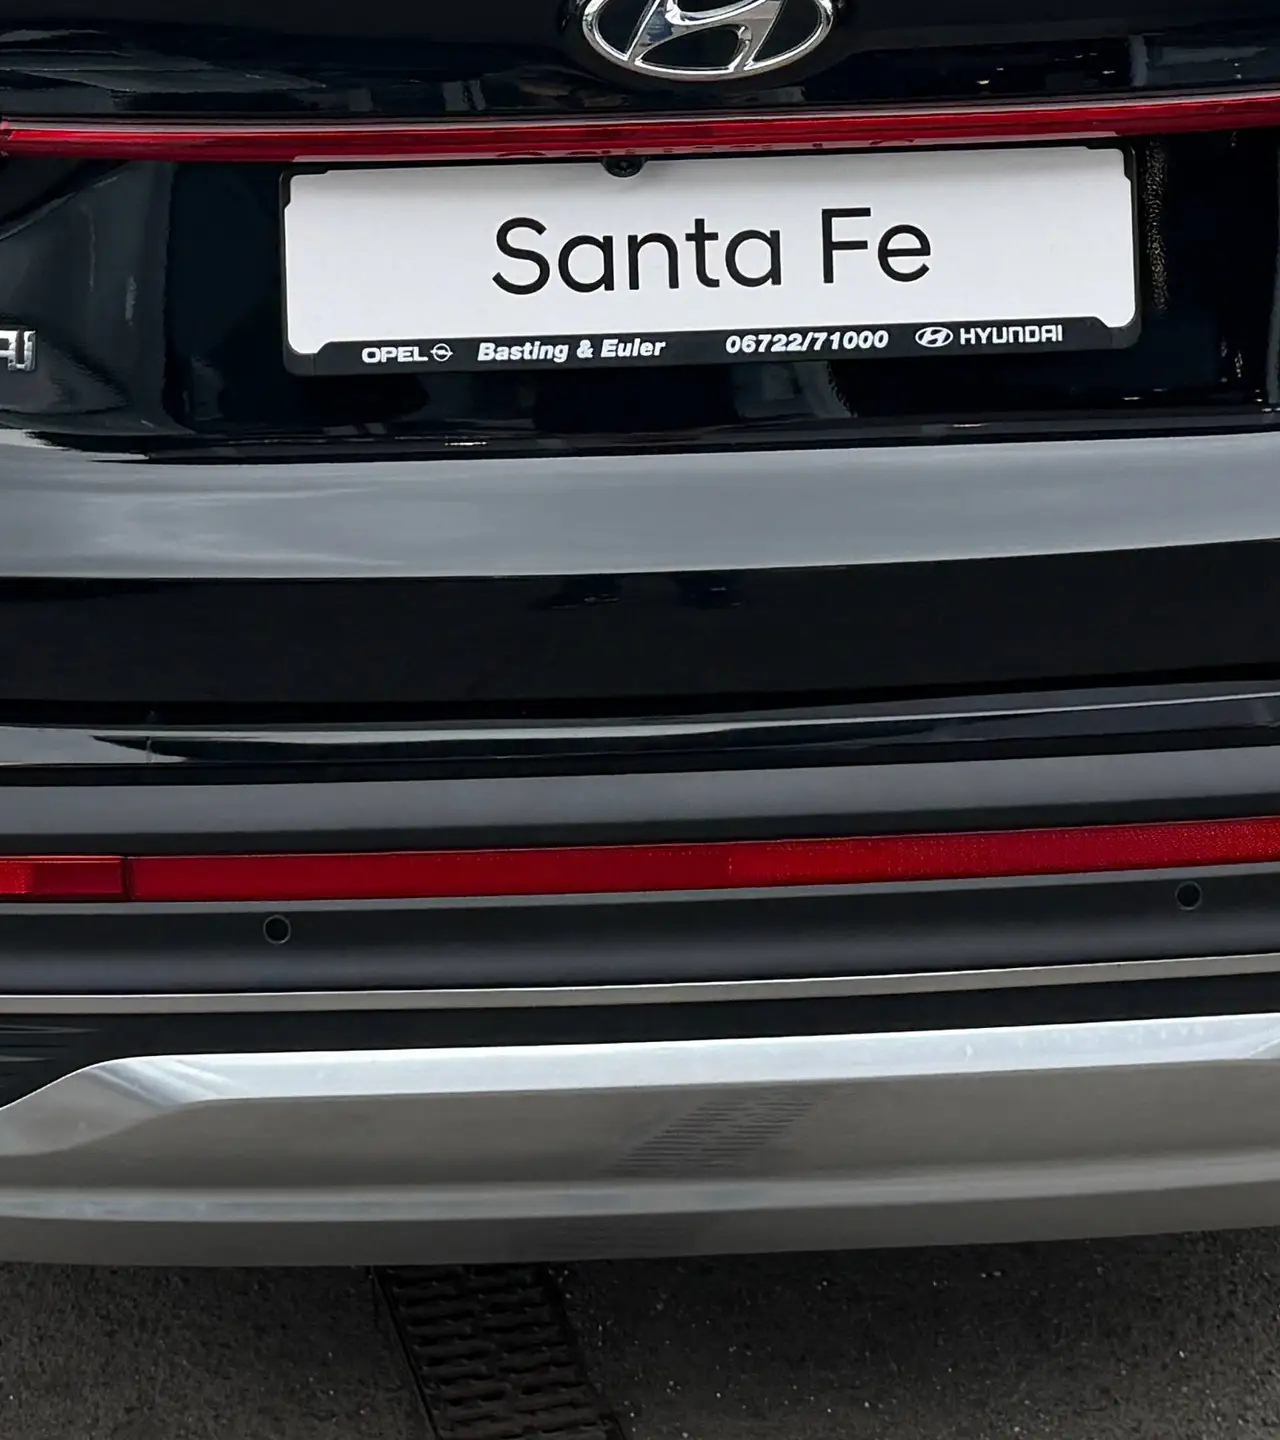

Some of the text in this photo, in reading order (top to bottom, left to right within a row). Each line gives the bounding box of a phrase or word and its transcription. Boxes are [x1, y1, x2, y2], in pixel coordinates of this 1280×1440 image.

[492, 207, 931, 295] Santa Fe
[361, 325, 1063, 363] OPEL Basting & Euler 06722/71000 HYUNDAI
